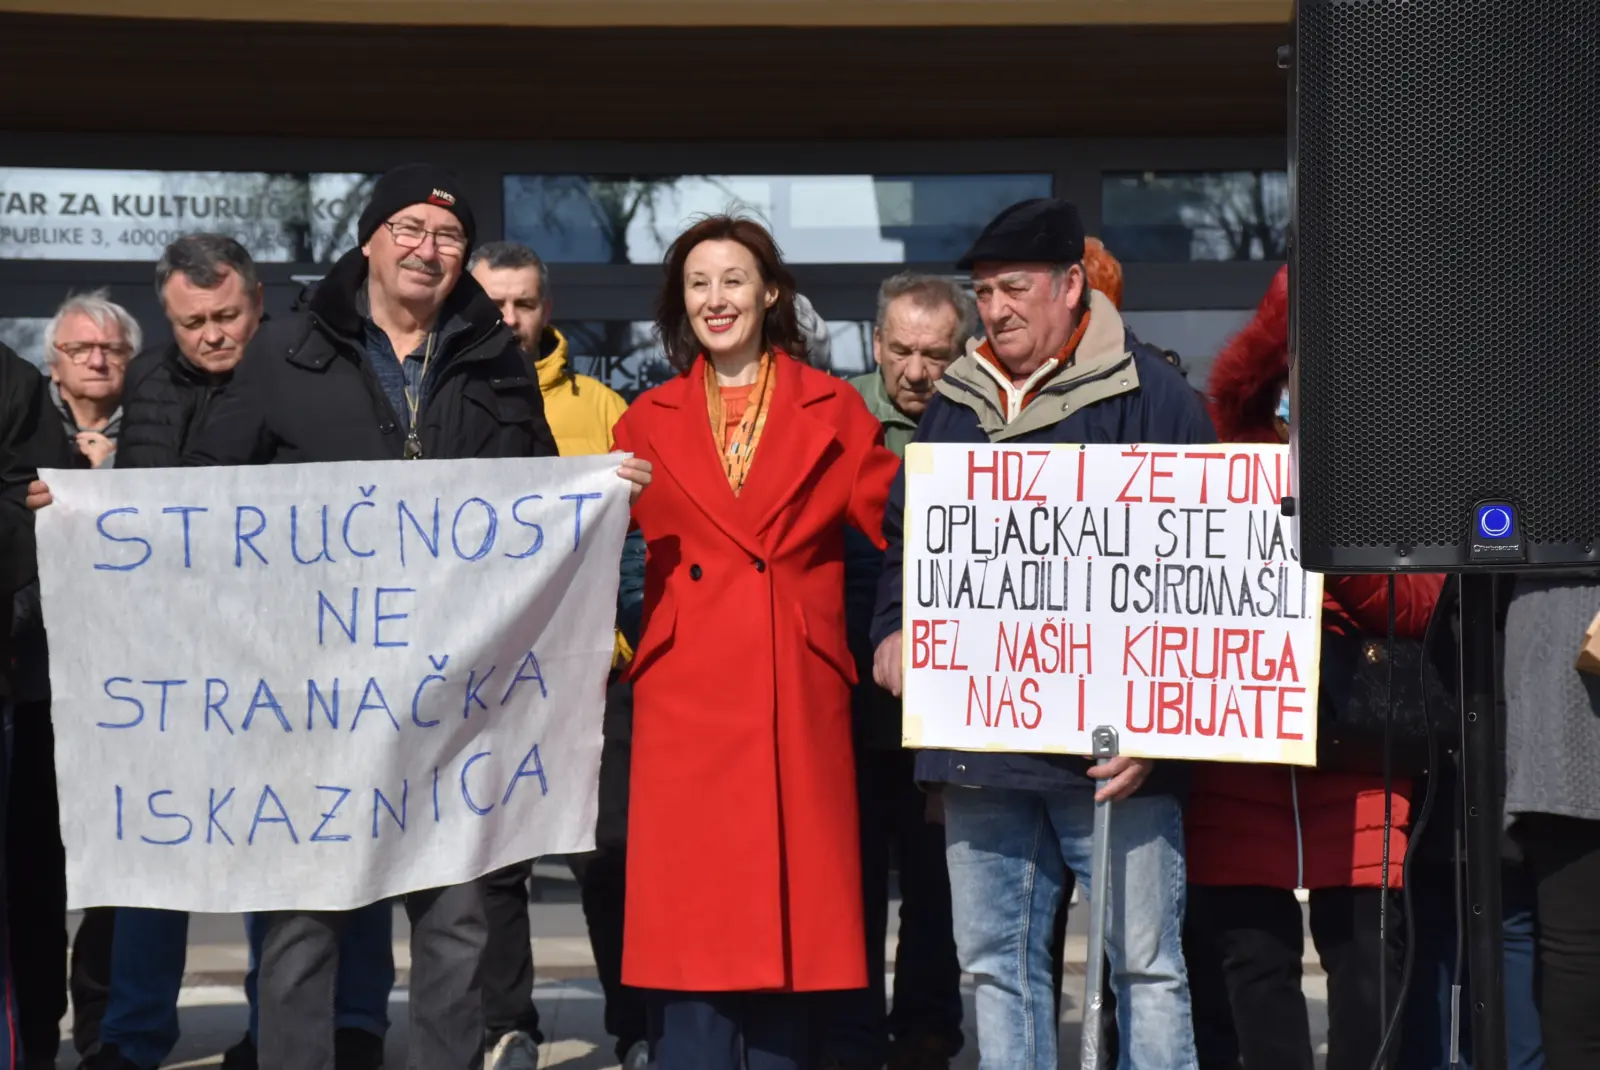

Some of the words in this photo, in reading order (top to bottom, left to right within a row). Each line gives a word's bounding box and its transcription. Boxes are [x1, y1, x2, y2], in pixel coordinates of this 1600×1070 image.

[59, 193, 100, 217] ZA
[112, 193, 253, 220] KULTURU
[91, 228, 109, 250] 3,
[967, 450, 1051, 501] HDZ
[93, 485, 603, 571] STRUČNOST
[1155, 508, 1228, 560] STE
[1247, 509, 1299, 561] NA
[917, 556, 1069, 611] UNAZADILI
[317, 587, 416, 647] NE
[912, 619, 969, 671] BEZ
[994, 617, 1092, 675] NAŠIH
[1122, 620, 1300, 683] KIRURGA
[97, 651, 548, 735] STRANAČKA
[965, 675, 1042, 730] NAS
[1125, 677, 1307, 741] UBIJATE
[115, 744, 549, 845] ISKAZNICA
